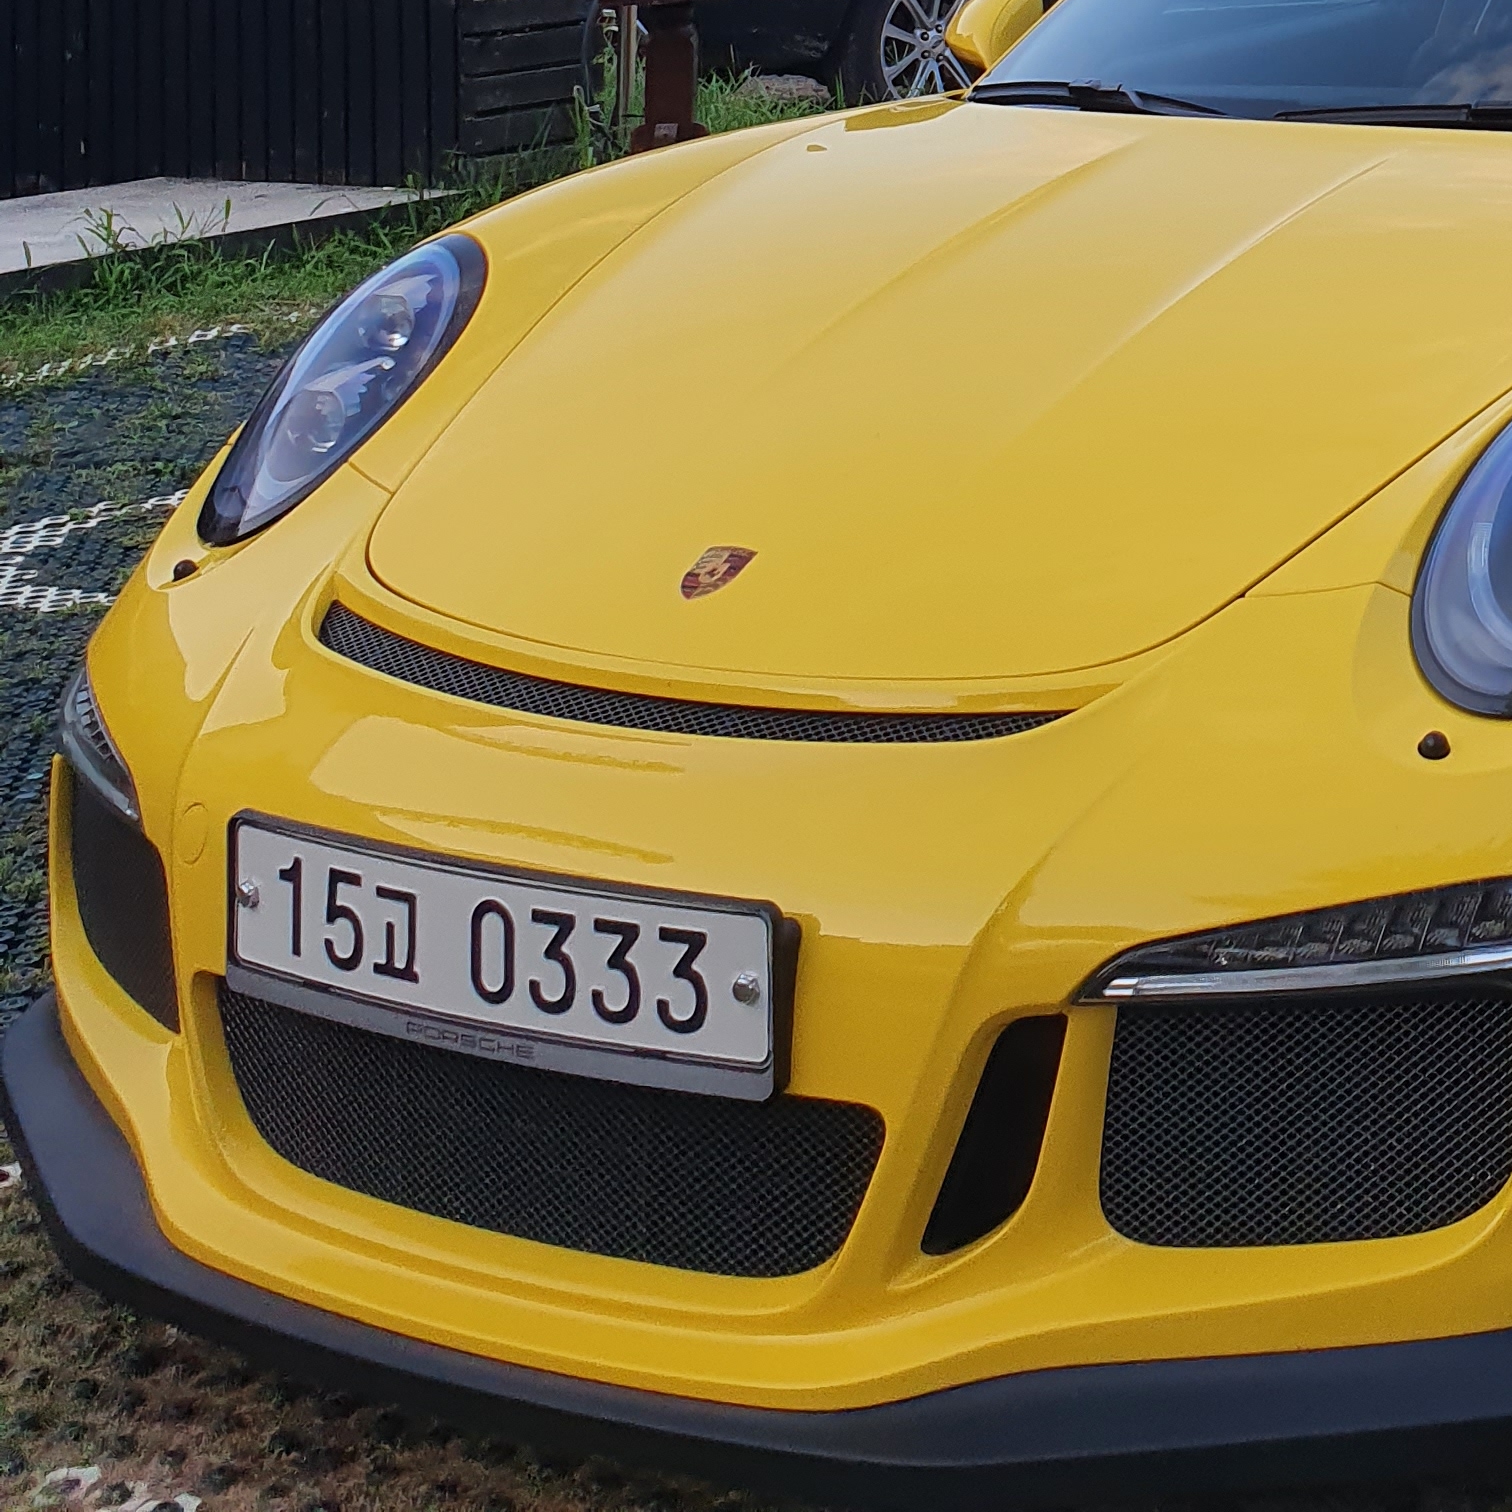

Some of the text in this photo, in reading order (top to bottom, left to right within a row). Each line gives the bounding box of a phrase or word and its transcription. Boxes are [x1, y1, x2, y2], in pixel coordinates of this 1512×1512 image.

[277, 855, 709, 1035] 15고 0333
[406, 1020, 535, 1060] PORSCHE
